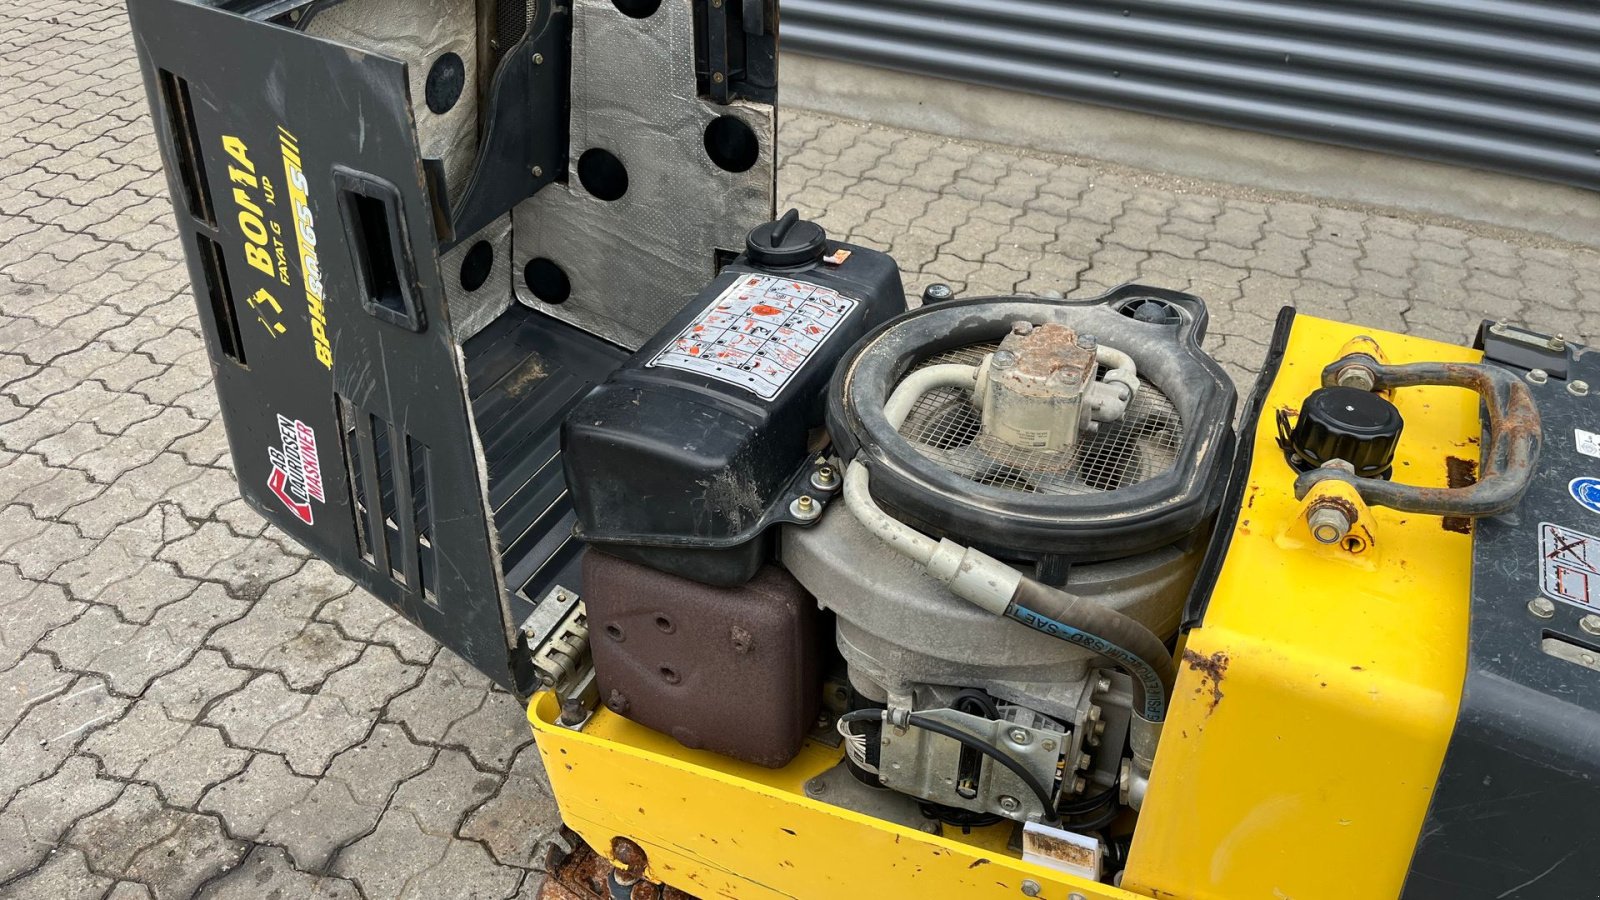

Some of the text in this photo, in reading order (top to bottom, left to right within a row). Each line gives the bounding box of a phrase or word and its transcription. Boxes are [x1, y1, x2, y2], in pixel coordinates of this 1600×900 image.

[289, 164, 309, 197] S
[261, 175, 291, 286] FAYAT GUP
[270, 448, 288, 473] AB
[296, 421, 324, 501] MASKINER
[1027, 613, 1059, 635] SAE
